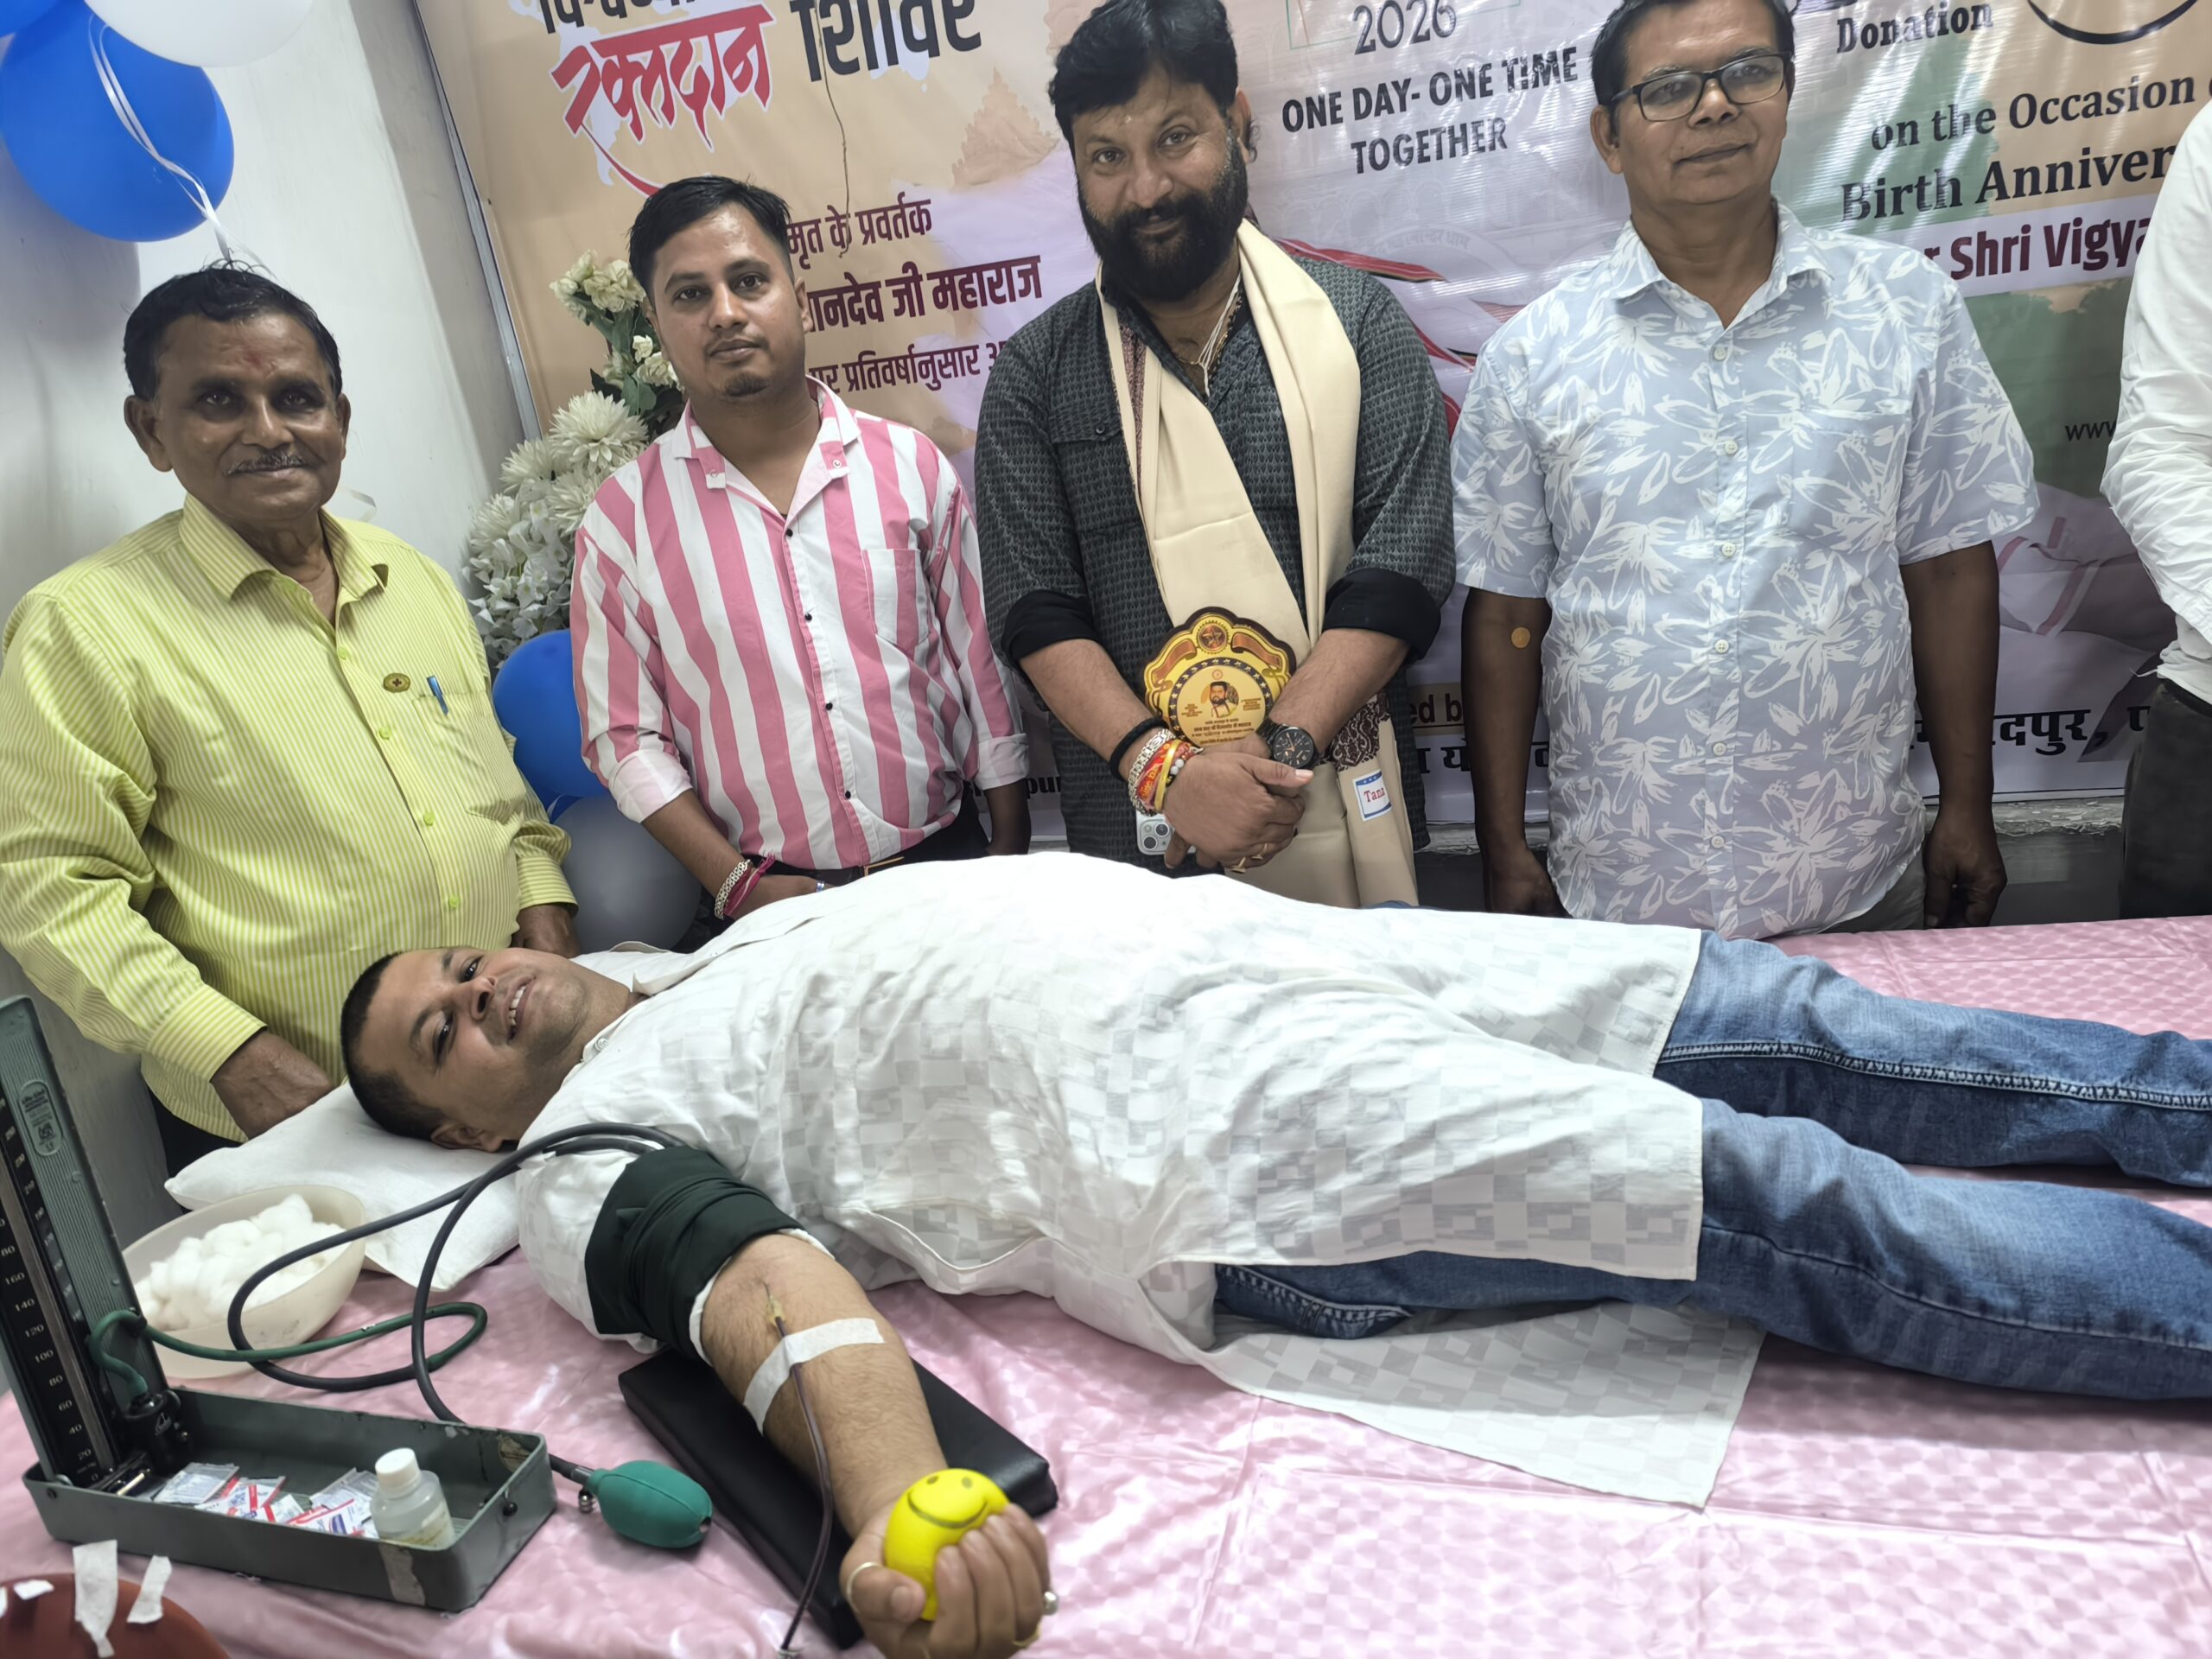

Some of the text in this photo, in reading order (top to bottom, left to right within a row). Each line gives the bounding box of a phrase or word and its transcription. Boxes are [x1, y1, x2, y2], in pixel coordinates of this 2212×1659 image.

[1353, 0, 1457, 54] 2026
[1837, 2, 1993, 54] Donation
[1282, 47, 1578, 133] ONE DAY- ONE TIME
[1872, 120, 1920, 151] on
[1931, 104, 1996, 142] the
[2009, 75, 2195, 130] Occasion
[1351, 117, 1508, 174] TOGETHER
[1842, 145, 2177, 223] Birth Anniver
[824, 205, 852, 249] के
[855, 191, 932, 245] प्रवर्तक
[1950, 223, 2032, 281] Shri
[885, 261, 925, 318] जी
[926, 255, 1042, 311] महाराज
[0, 1245, 16, 1257] 80
[5, 1272, 25, 1286] 160
[15, 1298, 35, 1312] 140
[24, 1324, 44, 1338] 120
[35, 1349, 54, 1363] 100
[58, 1400, 73, 1411] 60
[68, 1424, 82, 1435] 40
